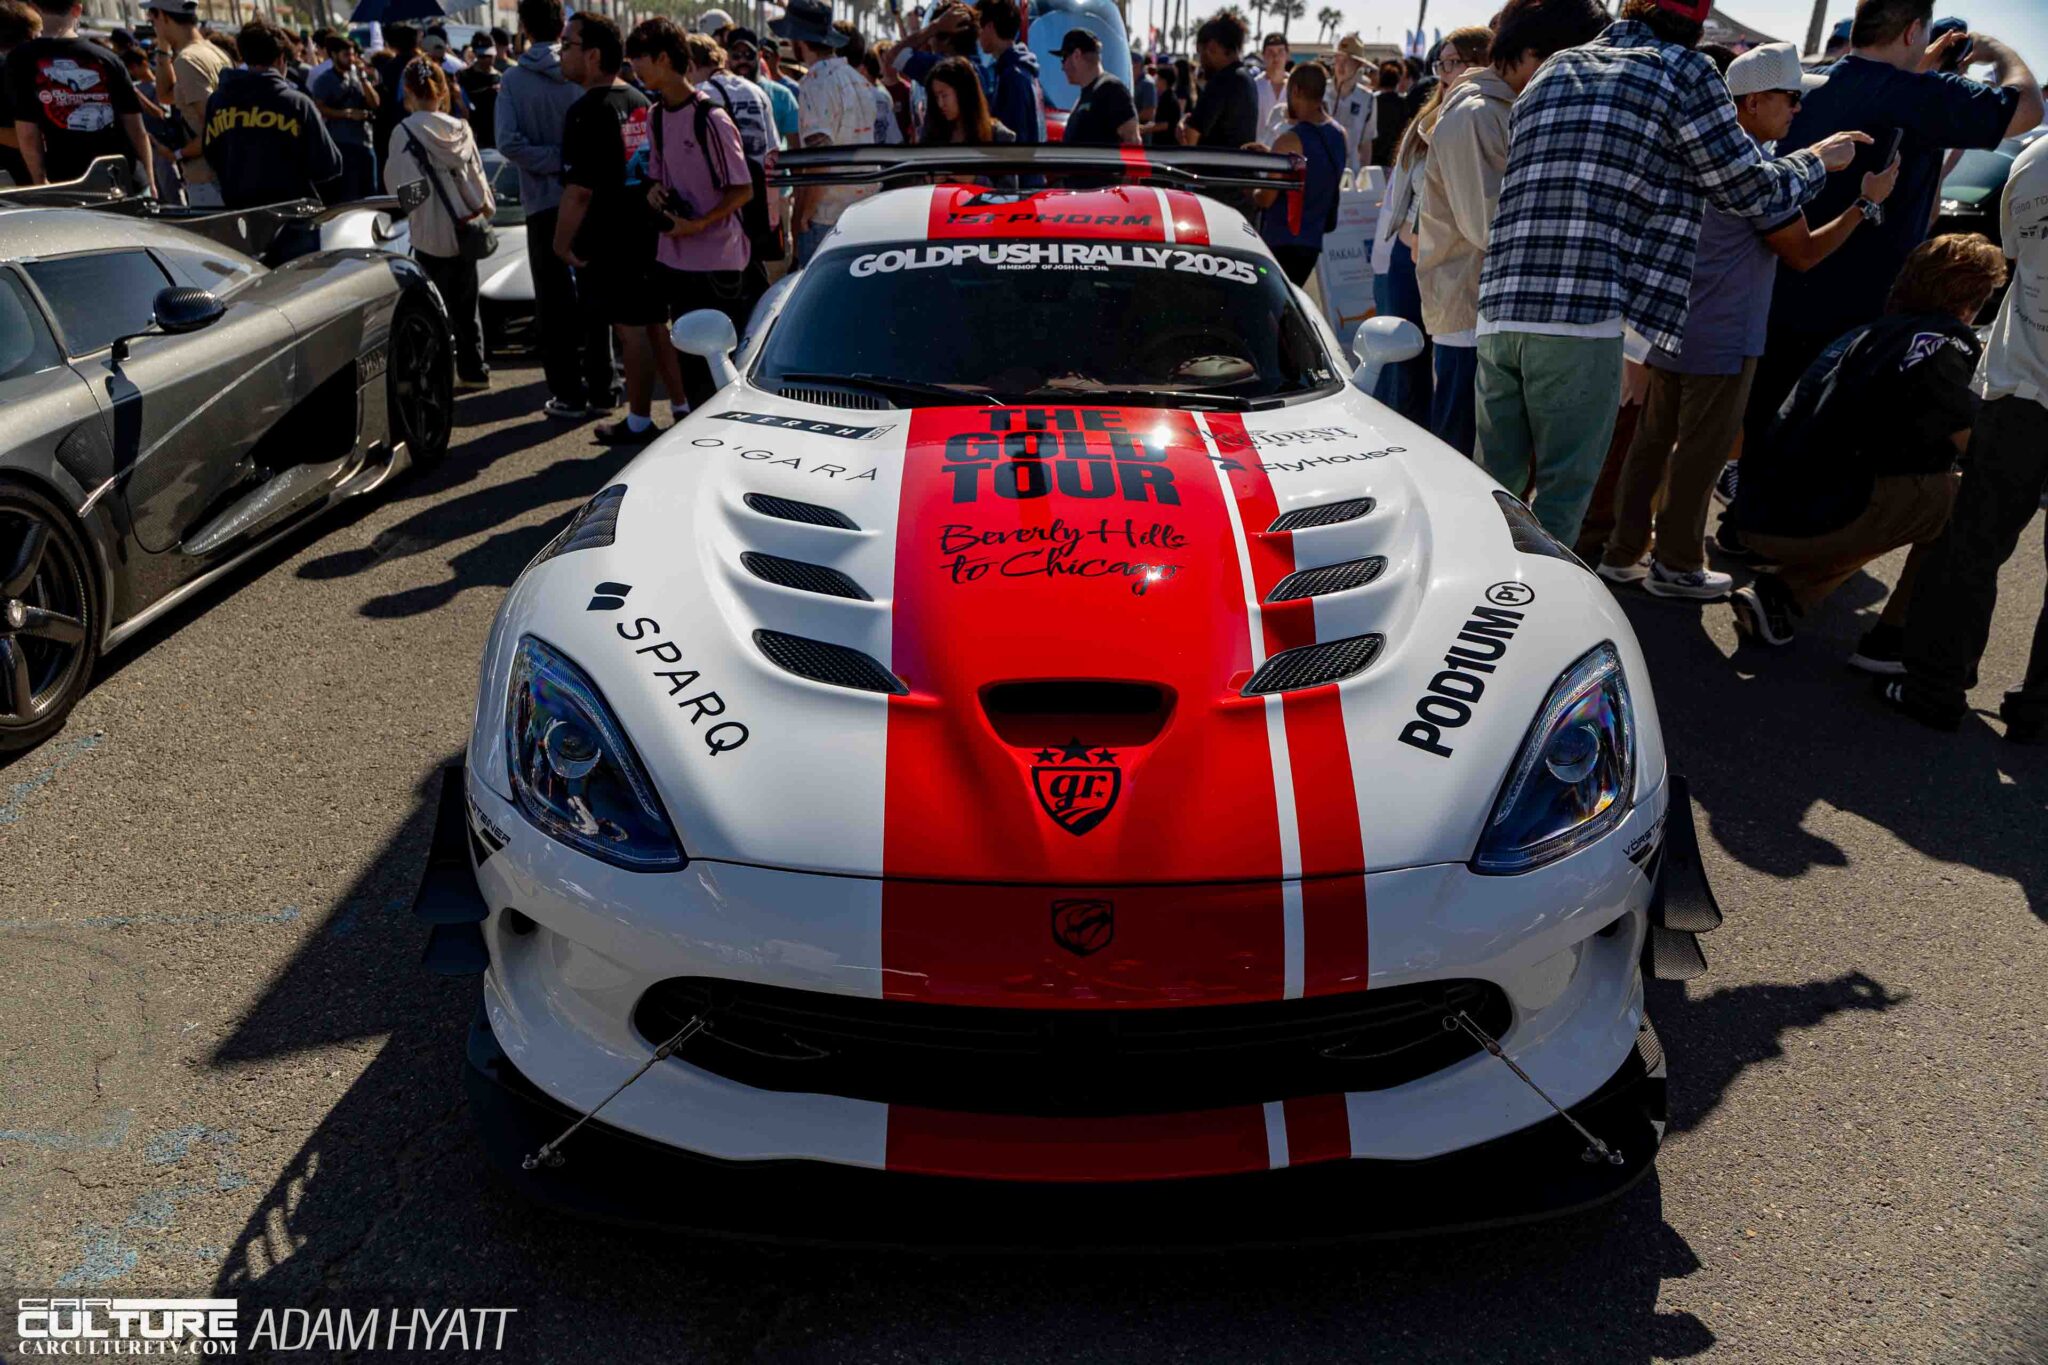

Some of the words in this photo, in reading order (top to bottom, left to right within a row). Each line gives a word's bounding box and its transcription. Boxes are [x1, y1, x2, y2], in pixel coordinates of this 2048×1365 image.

[947, 212, 1004, 225] 1ST
[1007, 213, 1152, 226] PHORM
[728, 412, 857, 436] MERCH
[979, 408, 1127, 432] THE
[691, 438, 877, 481] O'GARA
[945, 431, 1168, 463] GOLD
[1256, 446, 1407, 473] FlyHouse
[941, 460, 1181, 506] TOUR
[939, 519, 1083, 557] Beverly
[1087, 519, 1190, 549] Hills
[940, 554, 1000, 585] to
[1000, 548, 1184, 597] Chicago
[616, 617, 749, 756] SPARQ
[1397, 605, 1525, 759] POD1UM
